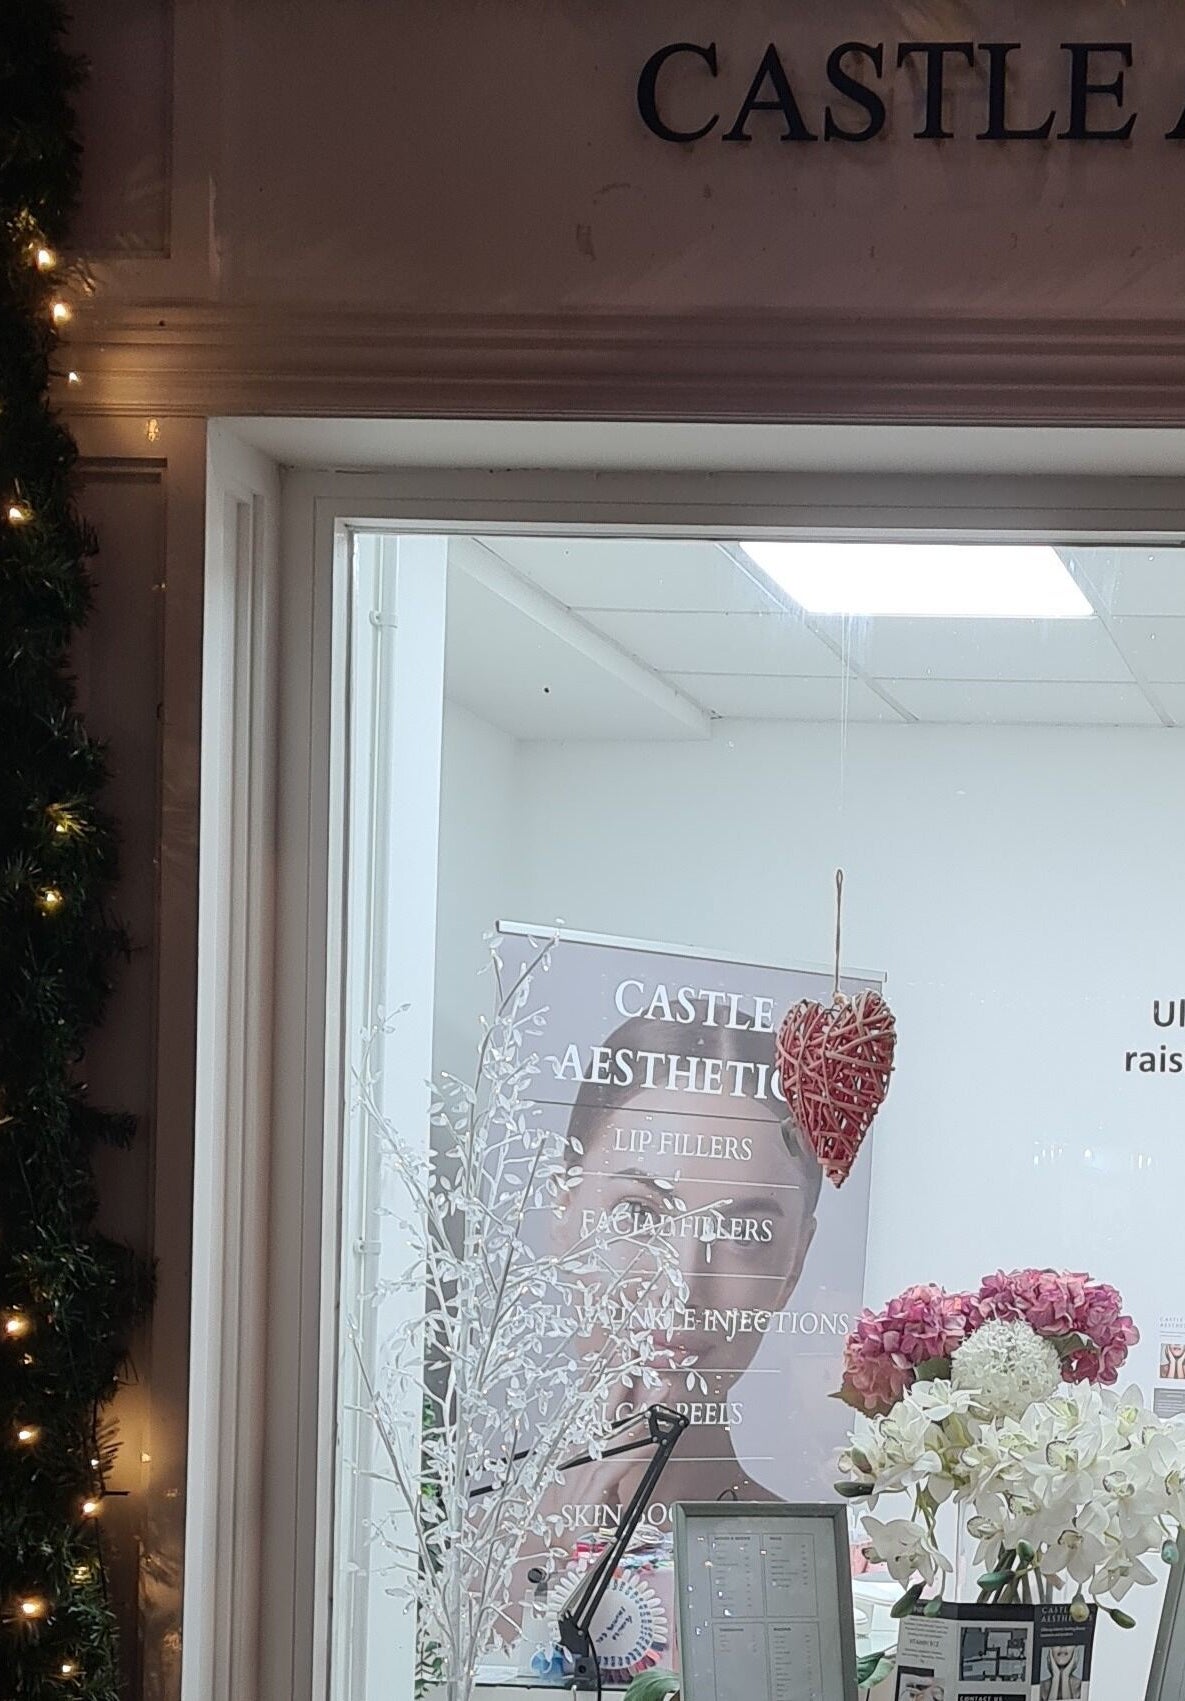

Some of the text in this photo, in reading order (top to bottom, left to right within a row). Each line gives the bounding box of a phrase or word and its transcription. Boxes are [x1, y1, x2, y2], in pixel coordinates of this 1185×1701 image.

[636, 41, 1138, 143] CASTLE
[614, 979, 776, 1034] CASTLE
[614, 1128, 754, 1161] LIP FILLERS
[680, 1214, 774, 1243] FILLERS
[703, 1308, 849, 1342] INJECTIONS
[561, 1503, 624, 1528] SKIN
